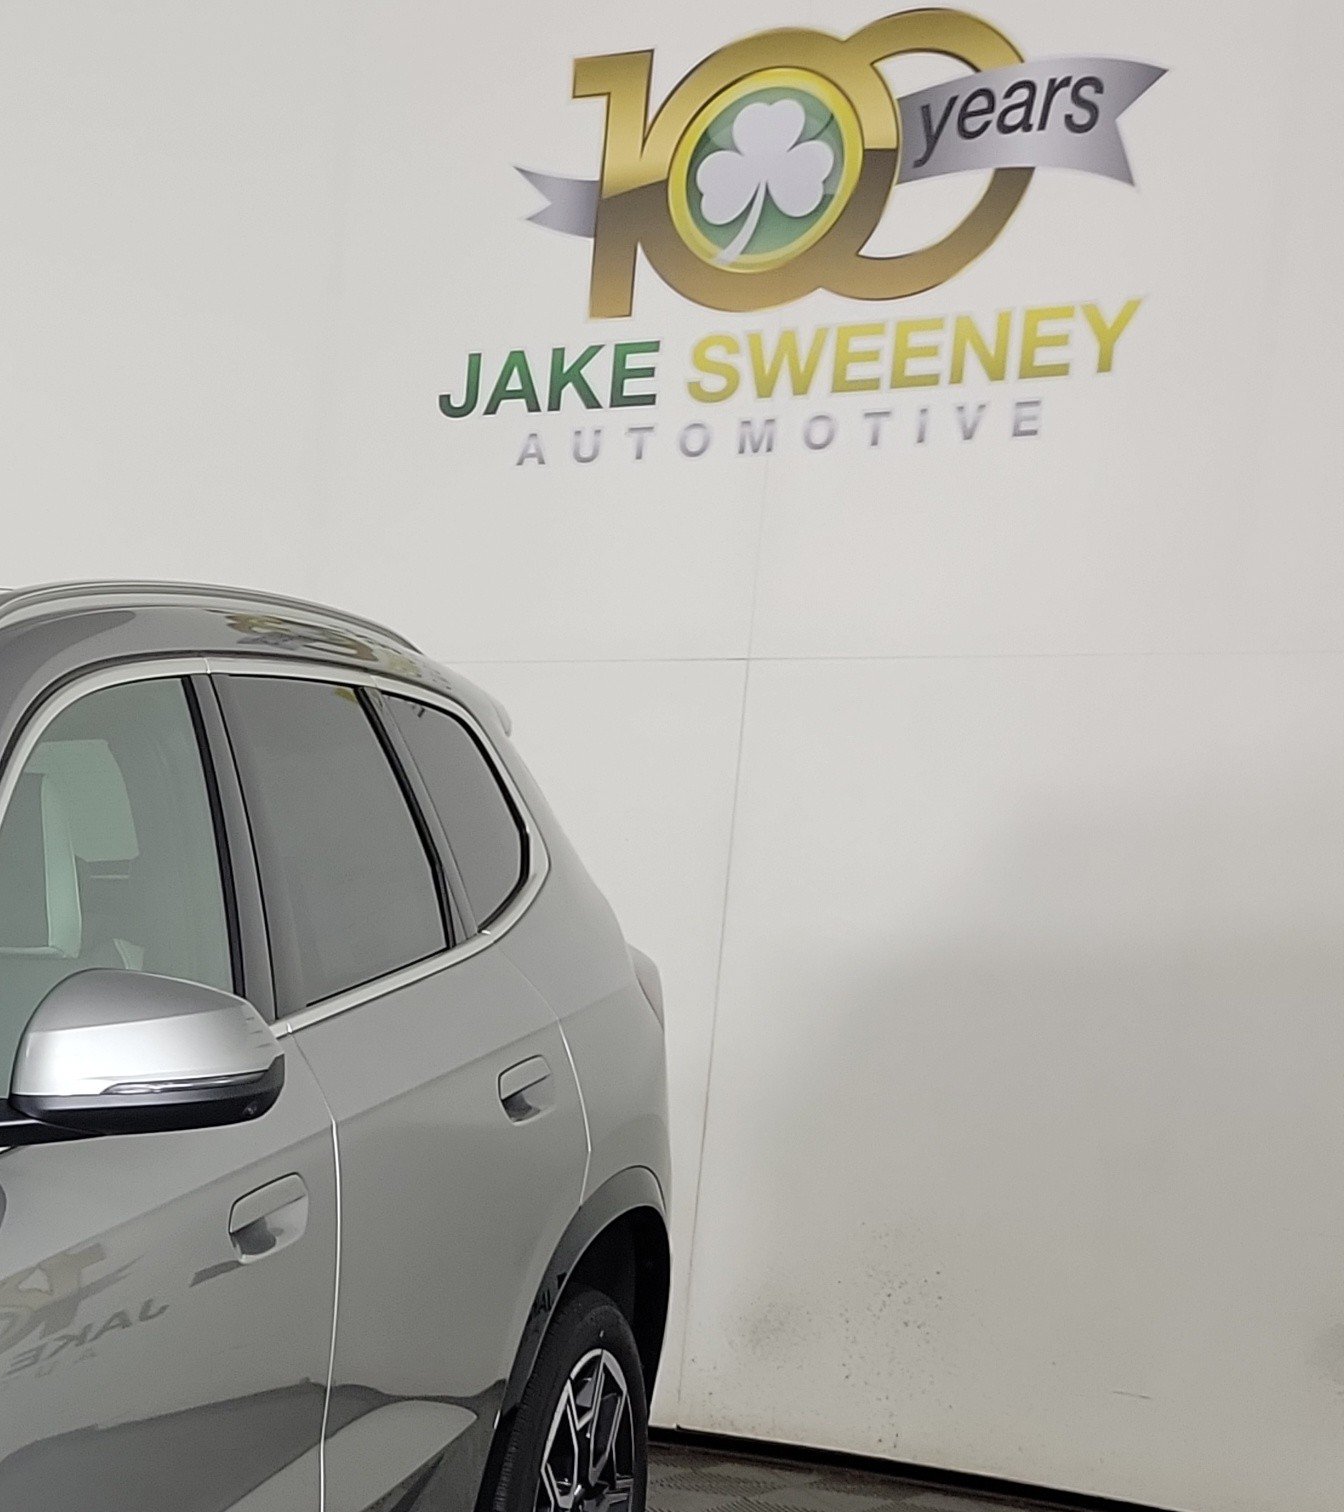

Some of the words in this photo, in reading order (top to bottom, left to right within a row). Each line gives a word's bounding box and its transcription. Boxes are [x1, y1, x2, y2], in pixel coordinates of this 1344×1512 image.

[572, 7, 1035, 319] 100
[912, 68, 1105, 167] years
[438, 340, 661, 418] JAKE
[687, 298, 1142, 403] SWEENEY
[516, 401, 1043, 466] AUTOMOTIVE
